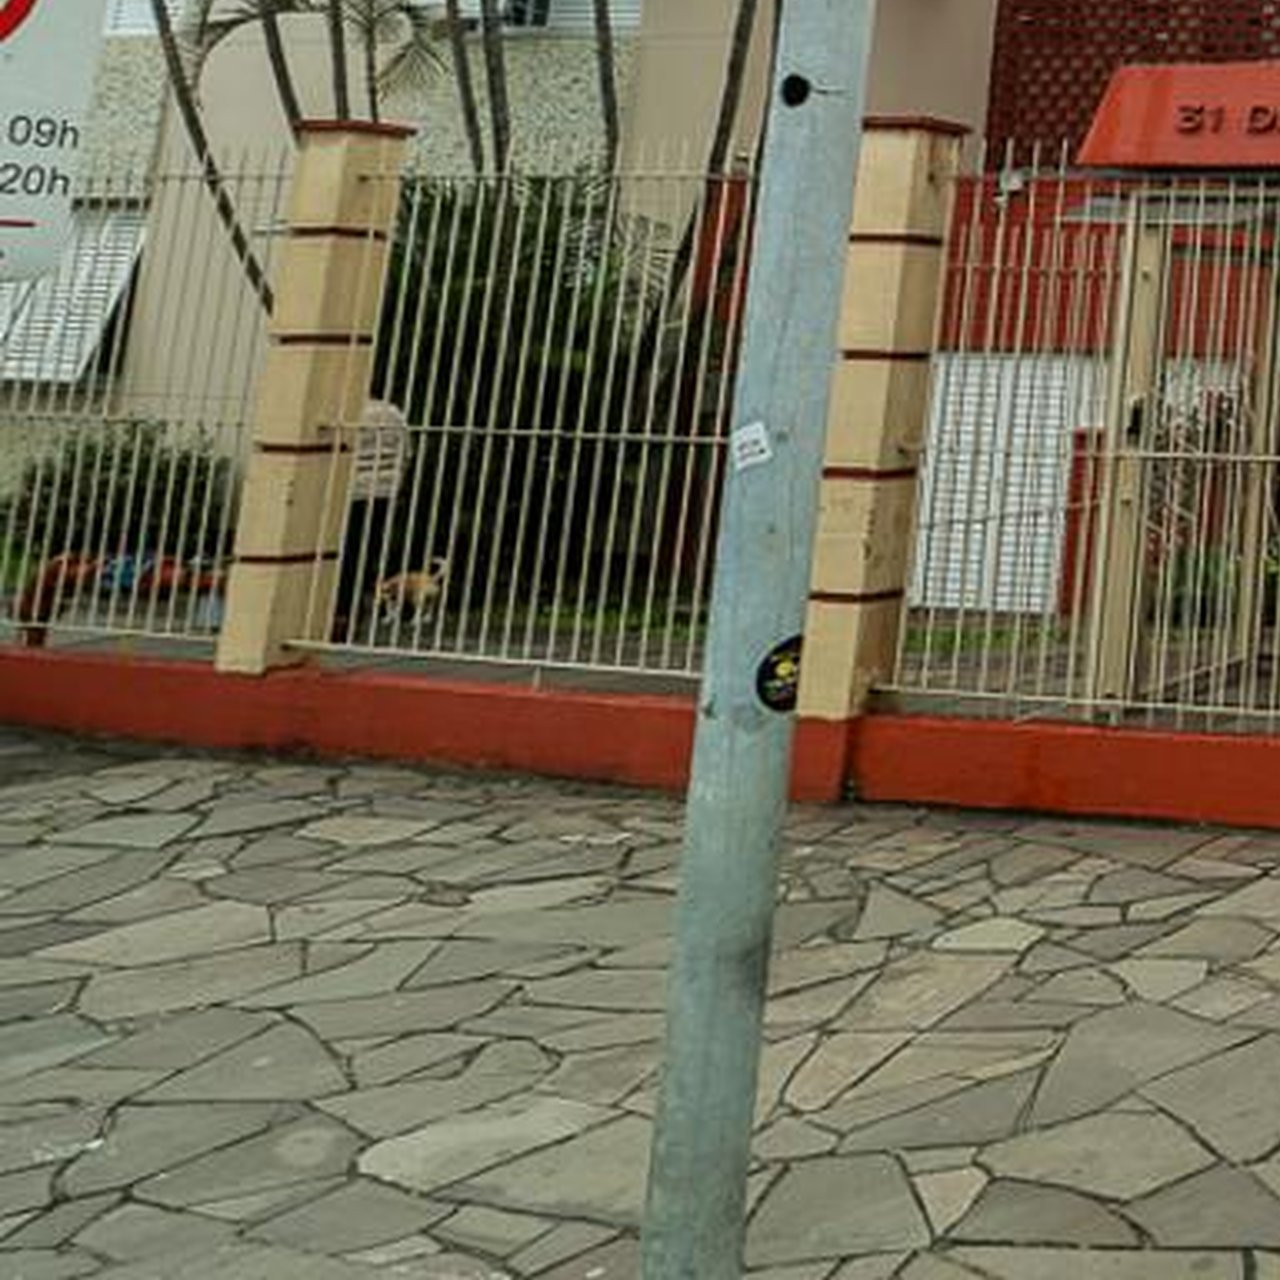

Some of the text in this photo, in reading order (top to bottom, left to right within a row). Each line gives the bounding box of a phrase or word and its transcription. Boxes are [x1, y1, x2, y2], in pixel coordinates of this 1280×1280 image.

[8, 115, 79, 149] 09h
[1178, 105, 1225, 135] 31
[0, 162, 70, 197] 20h
